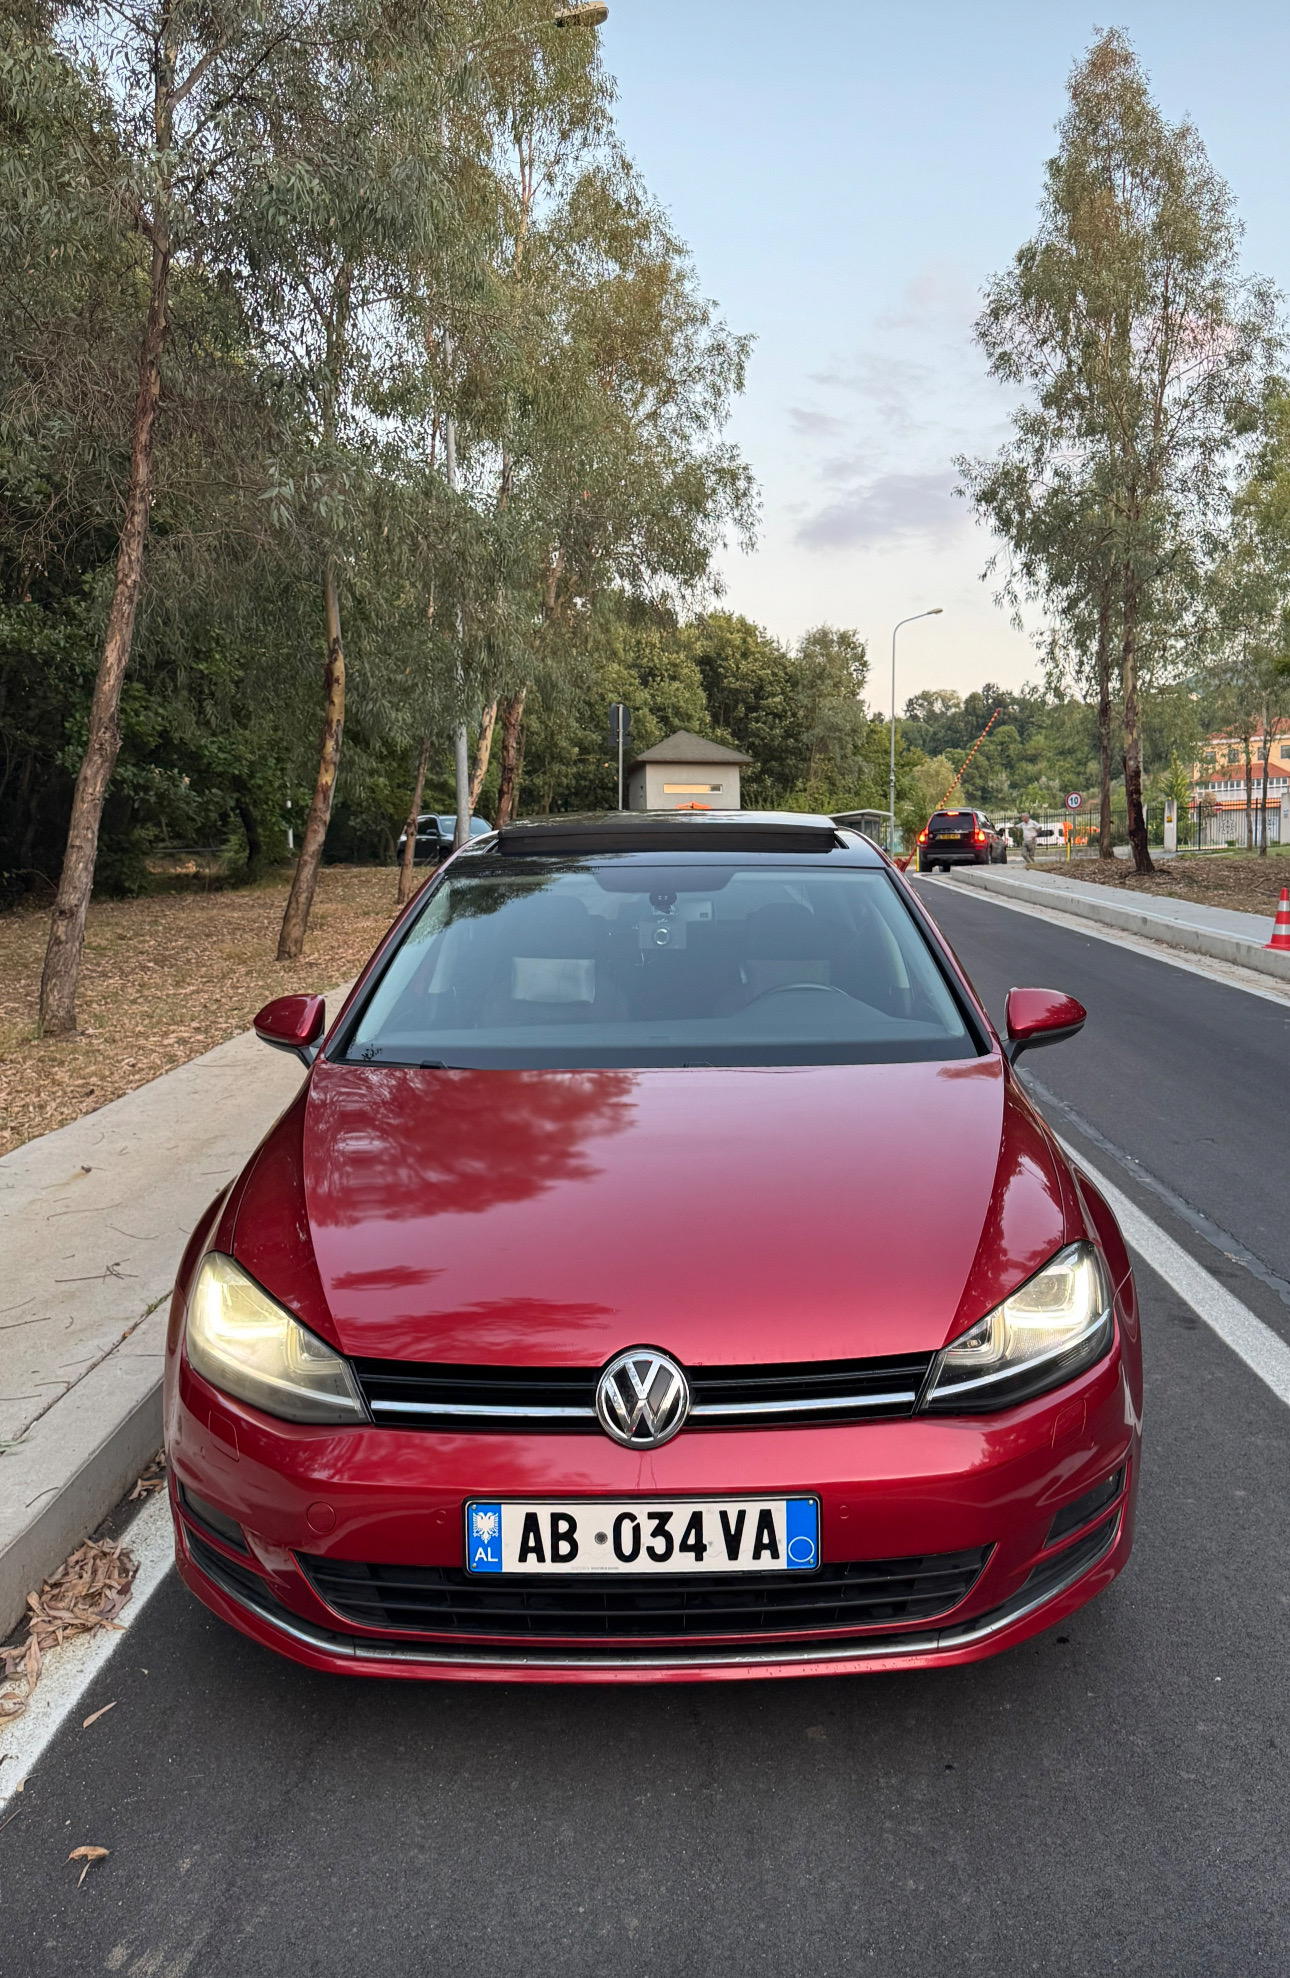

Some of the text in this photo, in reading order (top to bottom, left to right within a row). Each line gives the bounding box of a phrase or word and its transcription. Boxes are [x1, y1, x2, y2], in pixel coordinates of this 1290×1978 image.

[1069, 796, 1079, 805] 10
[518, 1509, 780, 1563] AB 034 VA
[475, 1549, 498, 1562] AL
